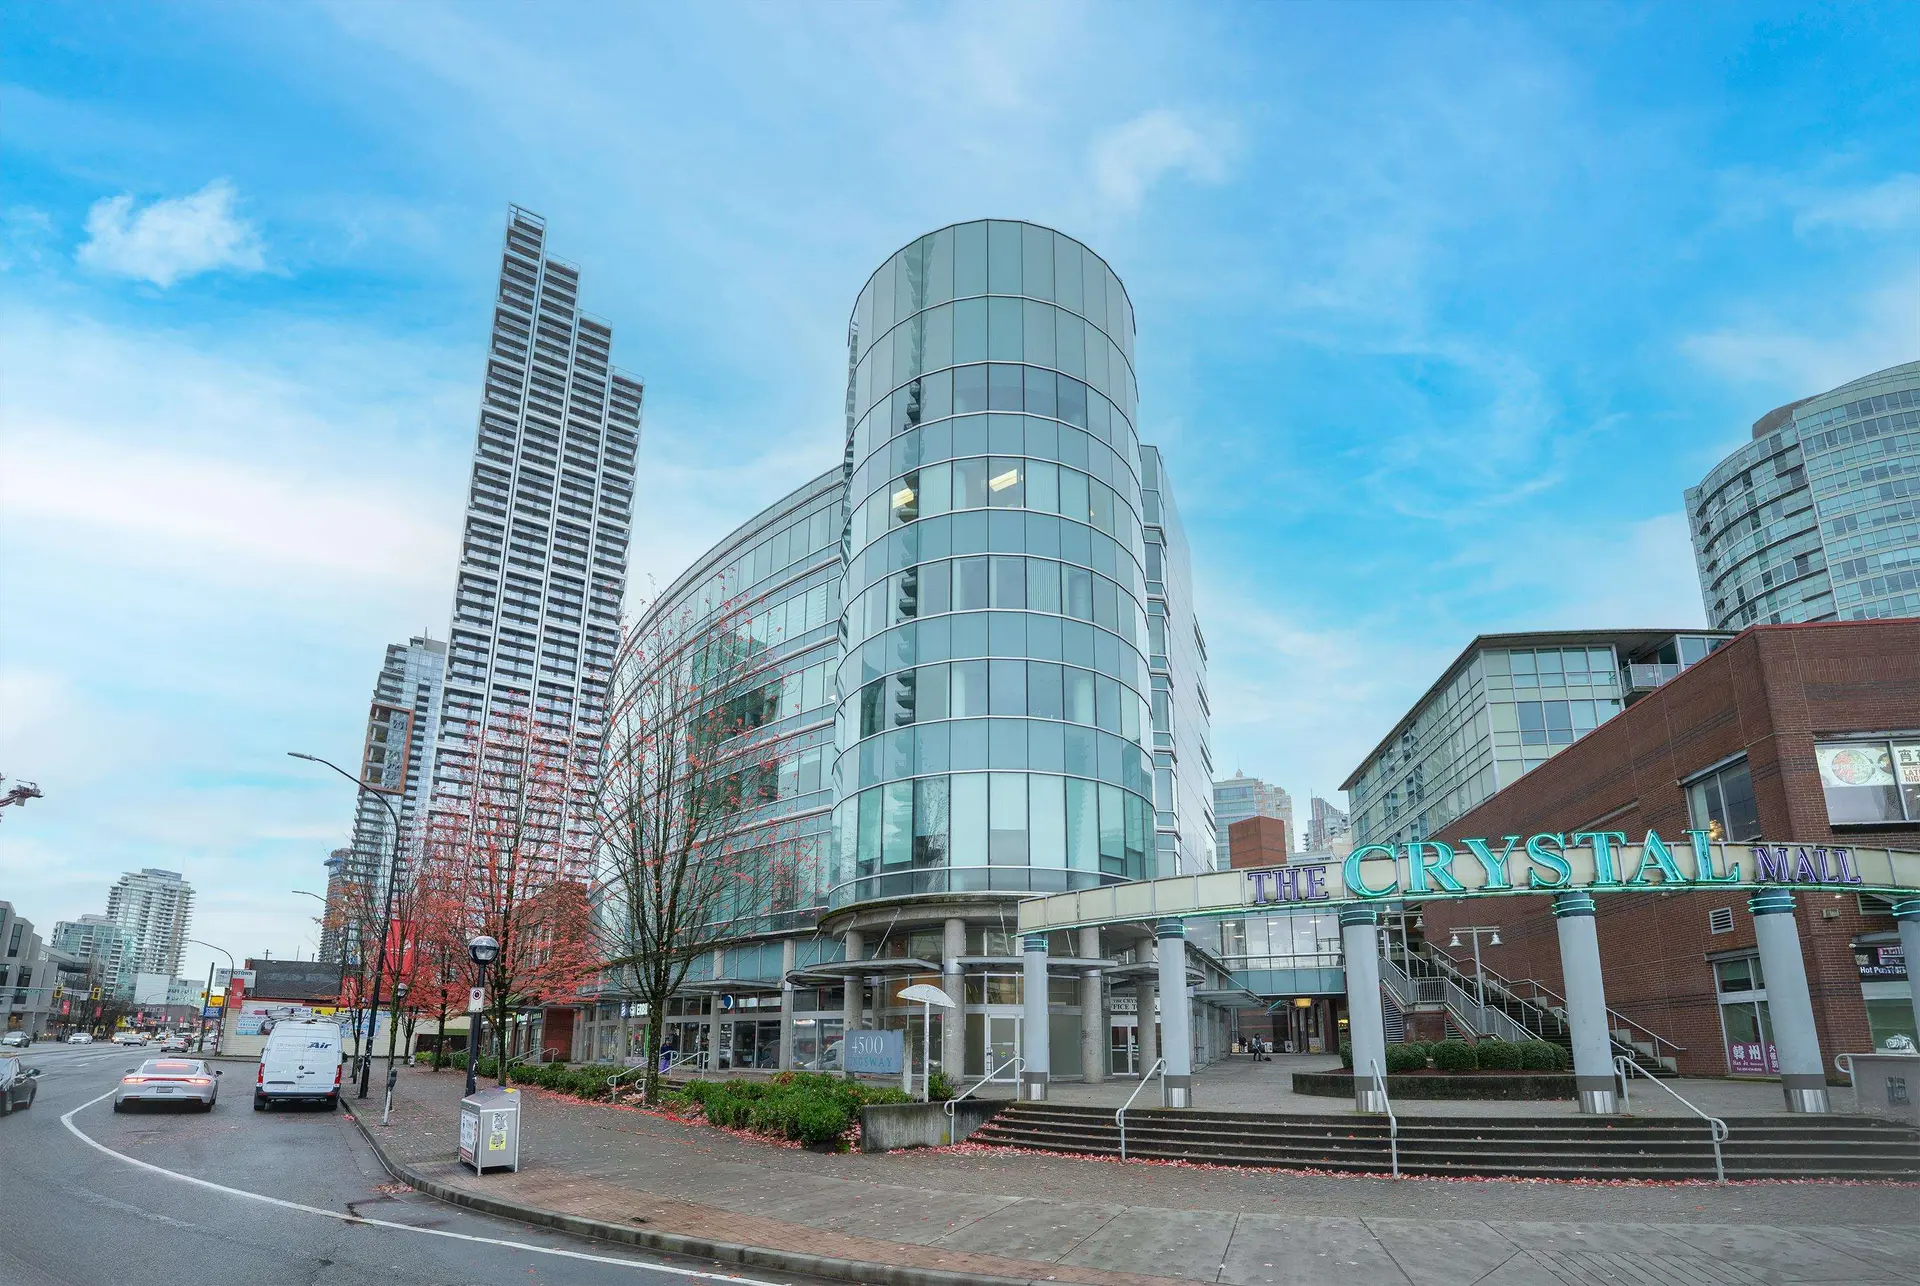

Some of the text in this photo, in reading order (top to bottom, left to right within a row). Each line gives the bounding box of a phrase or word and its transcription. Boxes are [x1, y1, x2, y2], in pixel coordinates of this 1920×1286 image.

[1247, 829, 1863, 904] THE CRYSTAL MALL
[307, 1041, 332, 1049] Air
[851, 1035, 884, 1055] 4500
